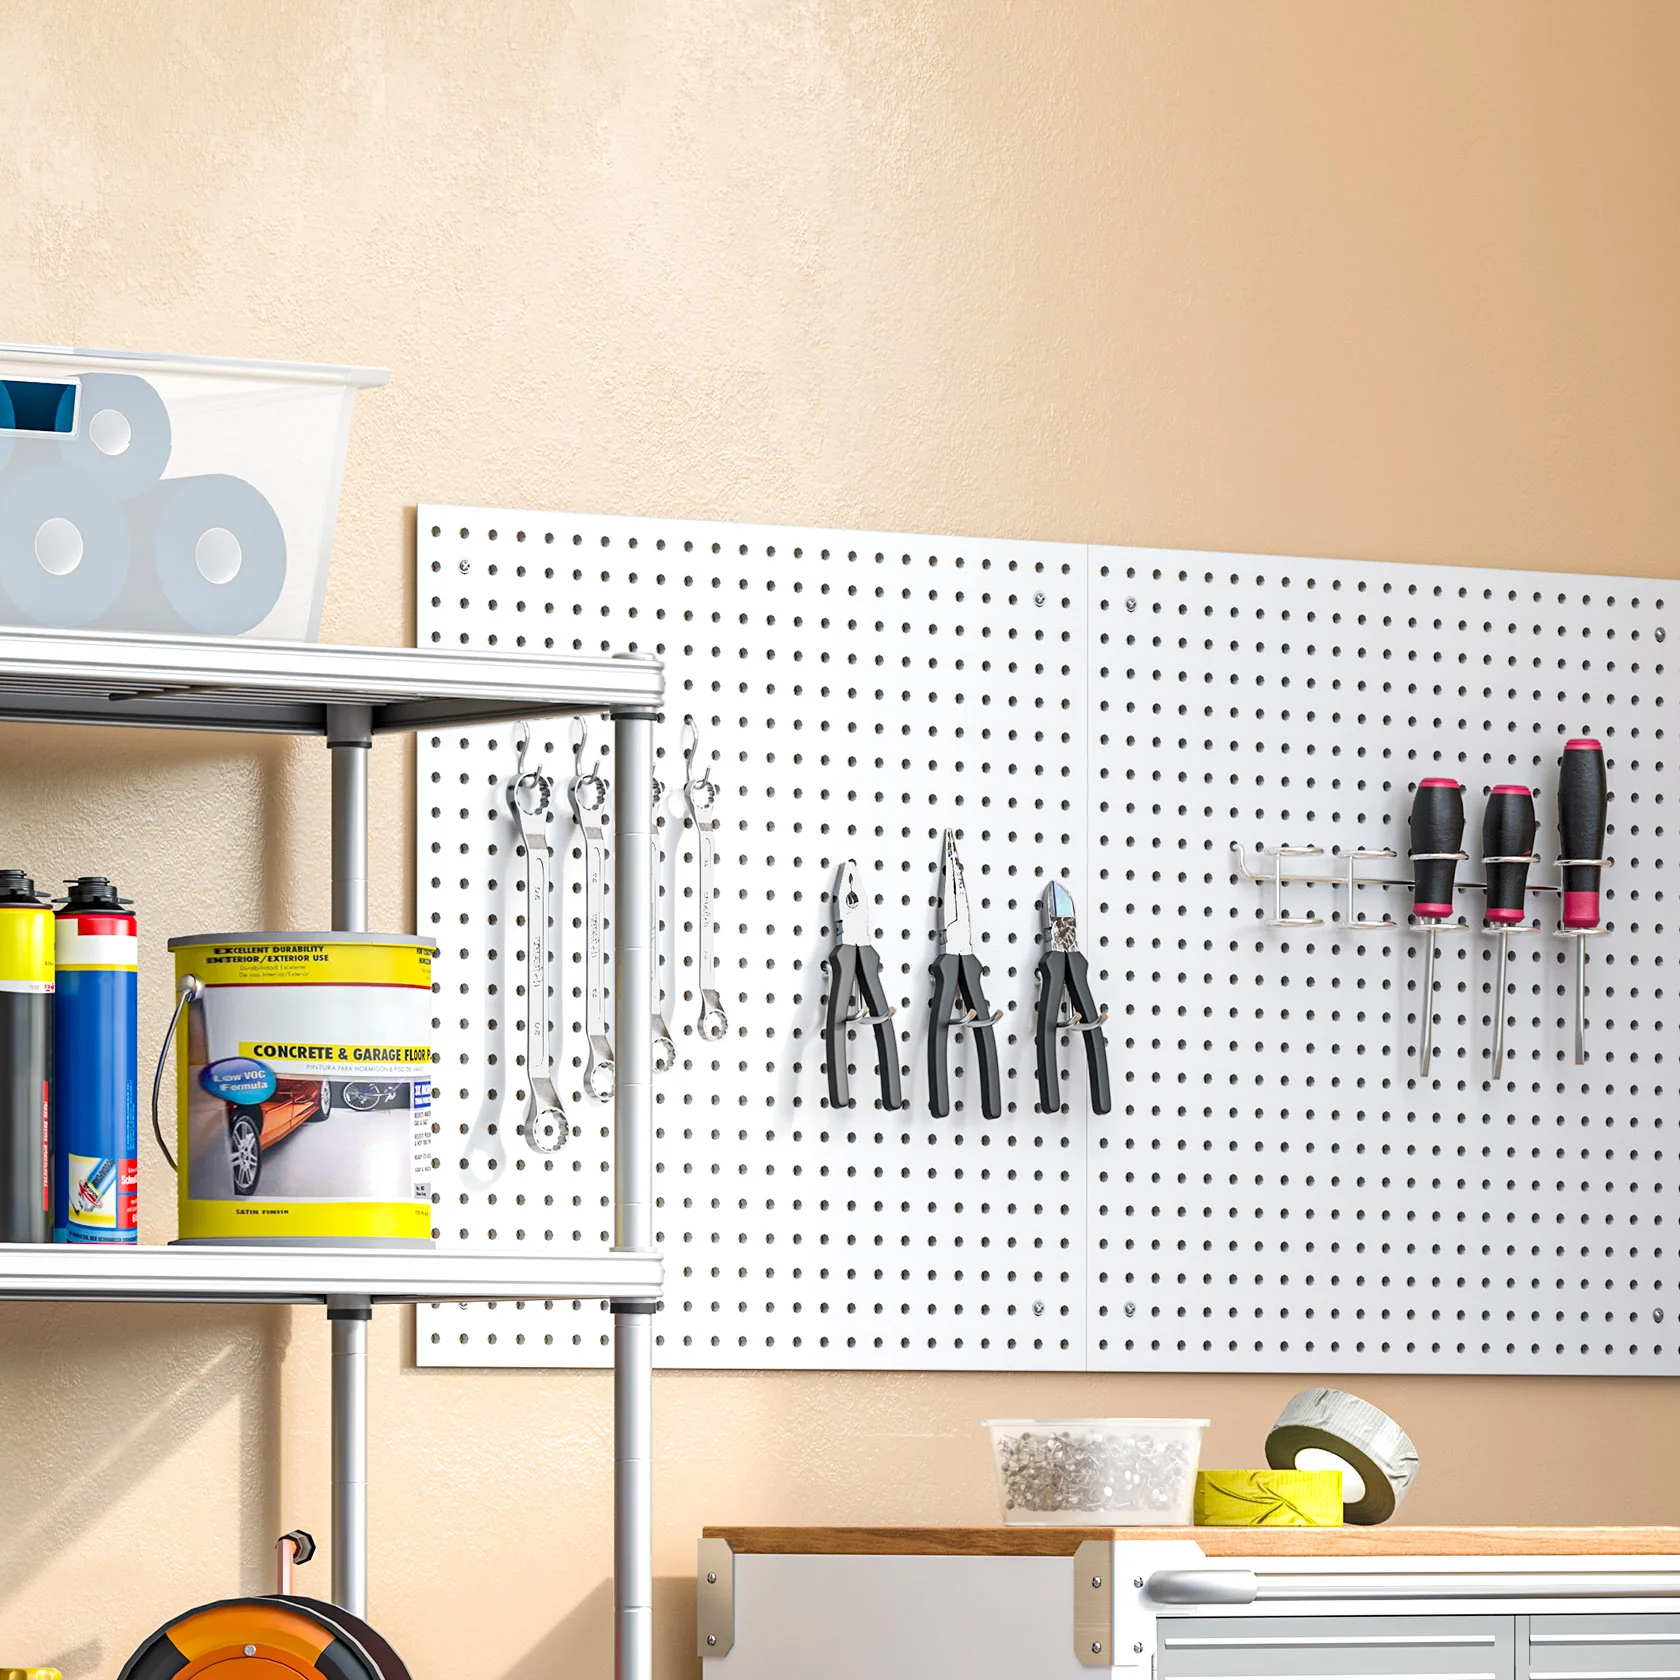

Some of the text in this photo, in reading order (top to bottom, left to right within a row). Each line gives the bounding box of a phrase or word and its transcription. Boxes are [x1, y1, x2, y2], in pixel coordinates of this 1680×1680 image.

[213, 945, 324, 954] EXCELLENT DURABILITY
[206, 955, 310, 964] INTERIOR/EXTERIOR
[253, 1045, 333, 1060] CONCRETE
[338, 1047, 349, 1060] &
[353, 1048, 402, 1061] GARAGE
[404, 1049, 426, 1061] FLOOR
[306, 1063, 336, 1071] PINTURA
[213, 1070, 266, 1082] Low VOC
[220, 1081, 268, 1091] Formula
